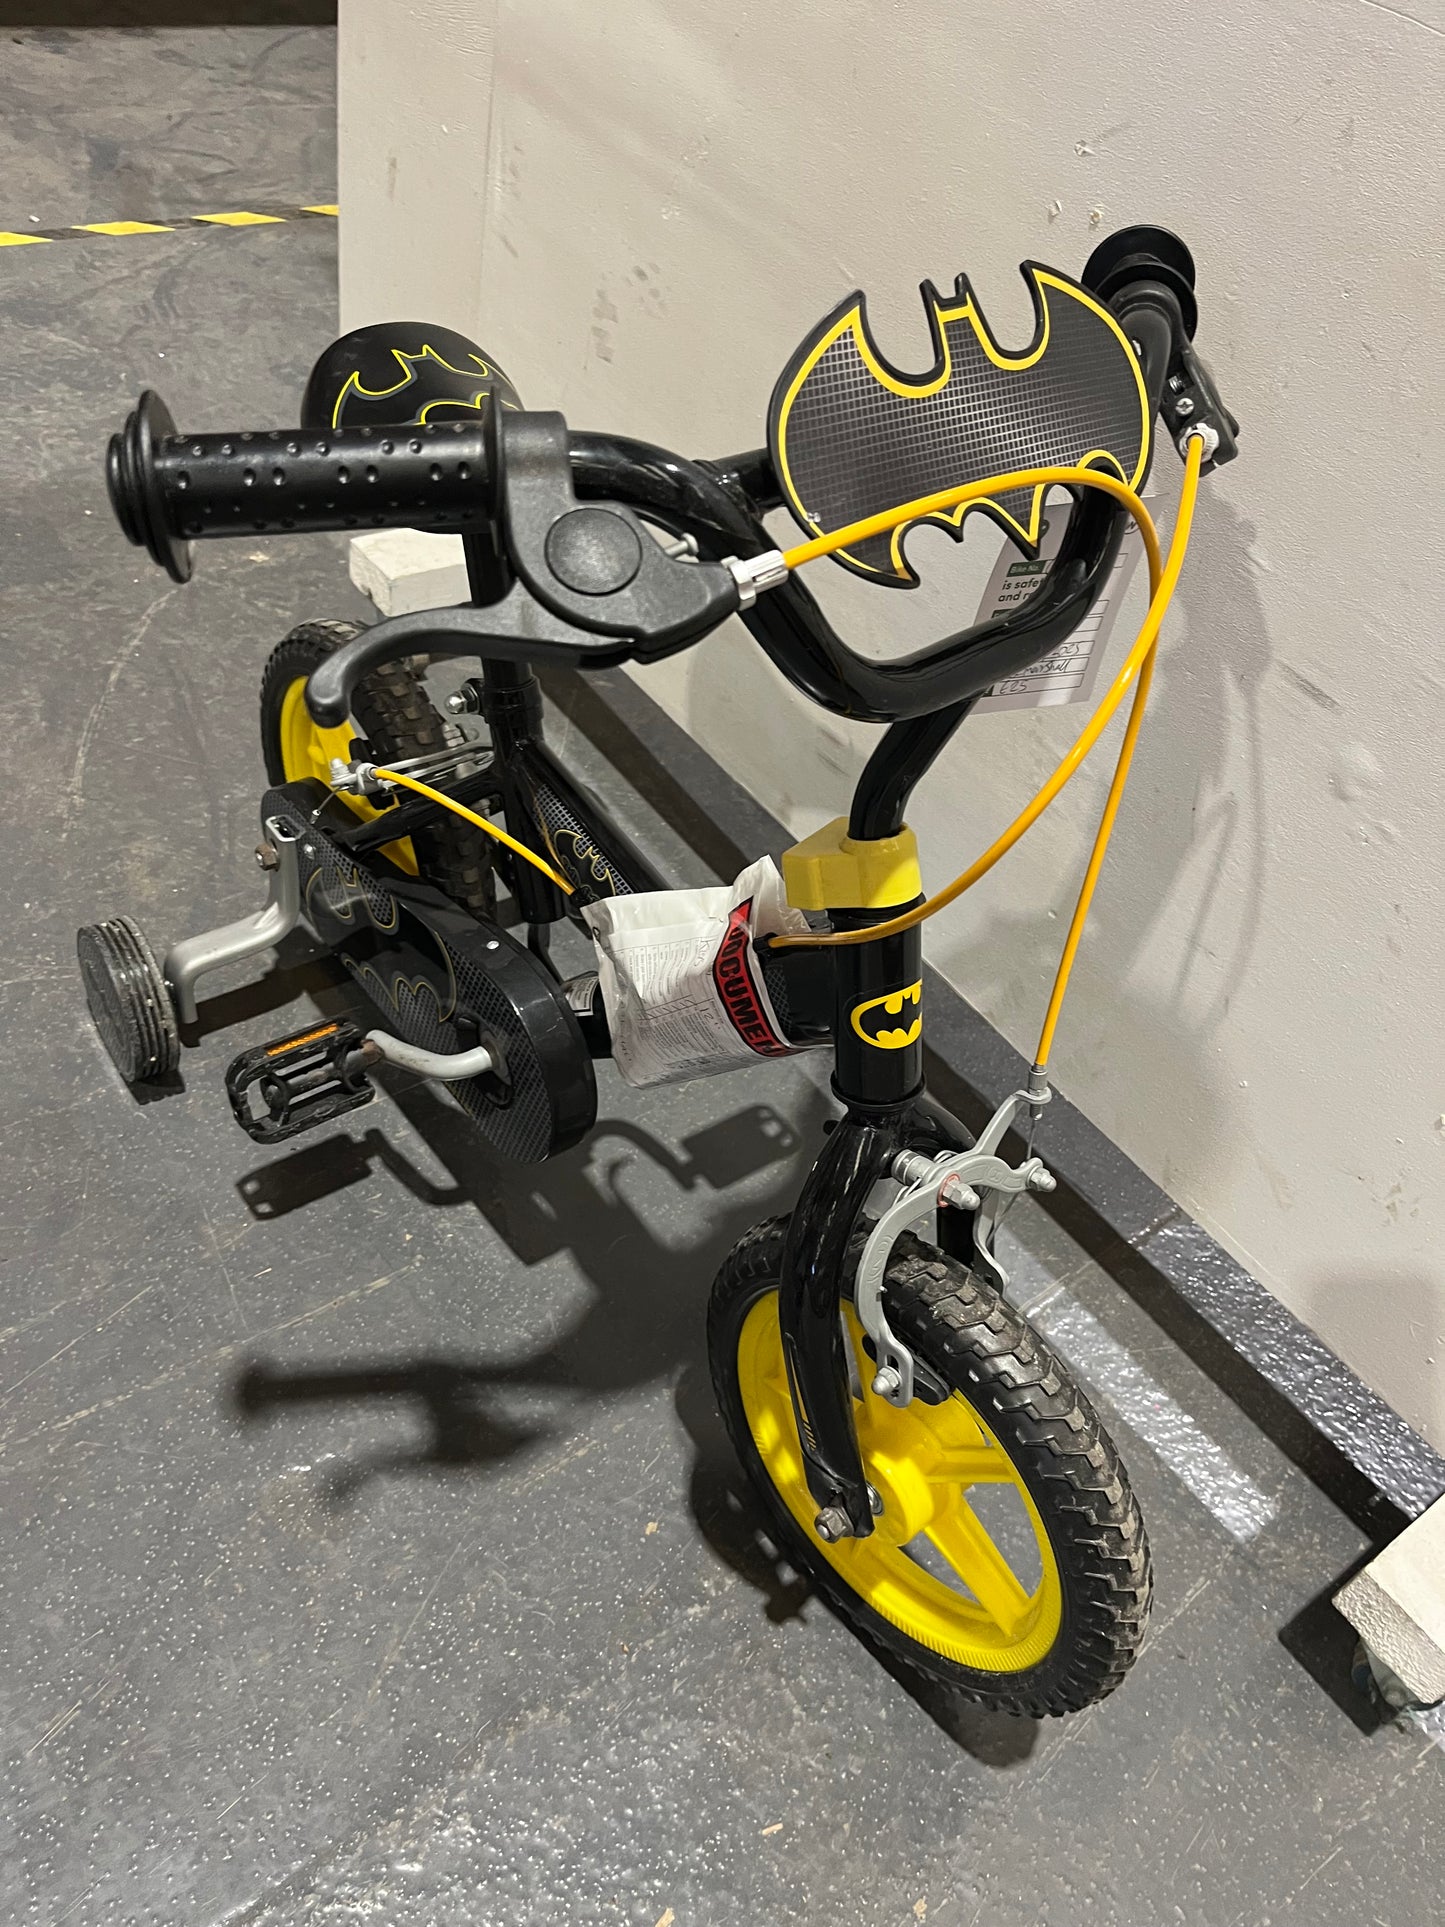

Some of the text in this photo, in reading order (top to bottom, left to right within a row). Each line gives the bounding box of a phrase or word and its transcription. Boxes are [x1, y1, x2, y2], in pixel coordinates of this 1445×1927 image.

[1001, 577, 1042, 590] is safe
[998, 590, 1022, 602] and
[719, 925, 776, 1052] DOCUMEN
